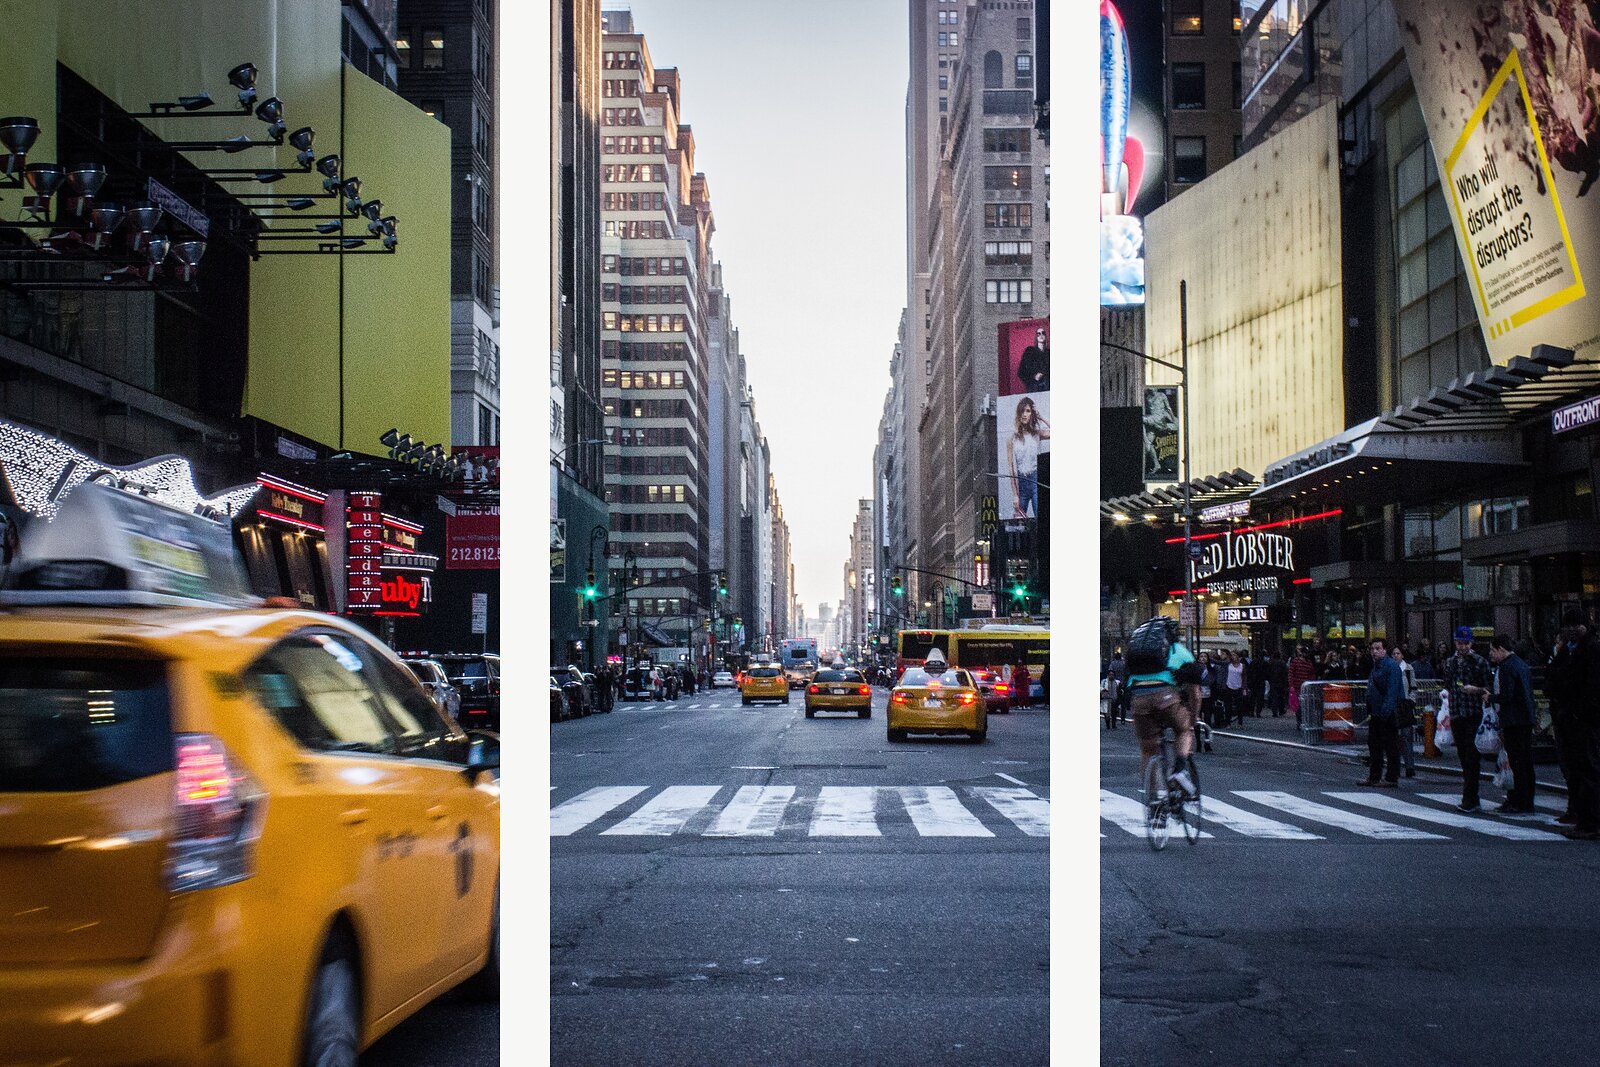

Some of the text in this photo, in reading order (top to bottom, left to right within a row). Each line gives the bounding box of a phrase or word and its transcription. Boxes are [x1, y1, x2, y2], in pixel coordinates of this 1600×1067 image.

[1456, 153, 1499, 203] Who will
[1467, 184, 1523, 236] disrupt the
[1476, 212, 1534, 268] disruptors?
[1554, 399, 1600, 430] OUTFRONT
[362, 496, 373, 602] Tuesday
[1225, 531, 1295, 571] LOBSTER
[380, 576, 421, 609] uby
[1207, 576, 1279, 594] FRESH FISH LIVE LOBSTER
